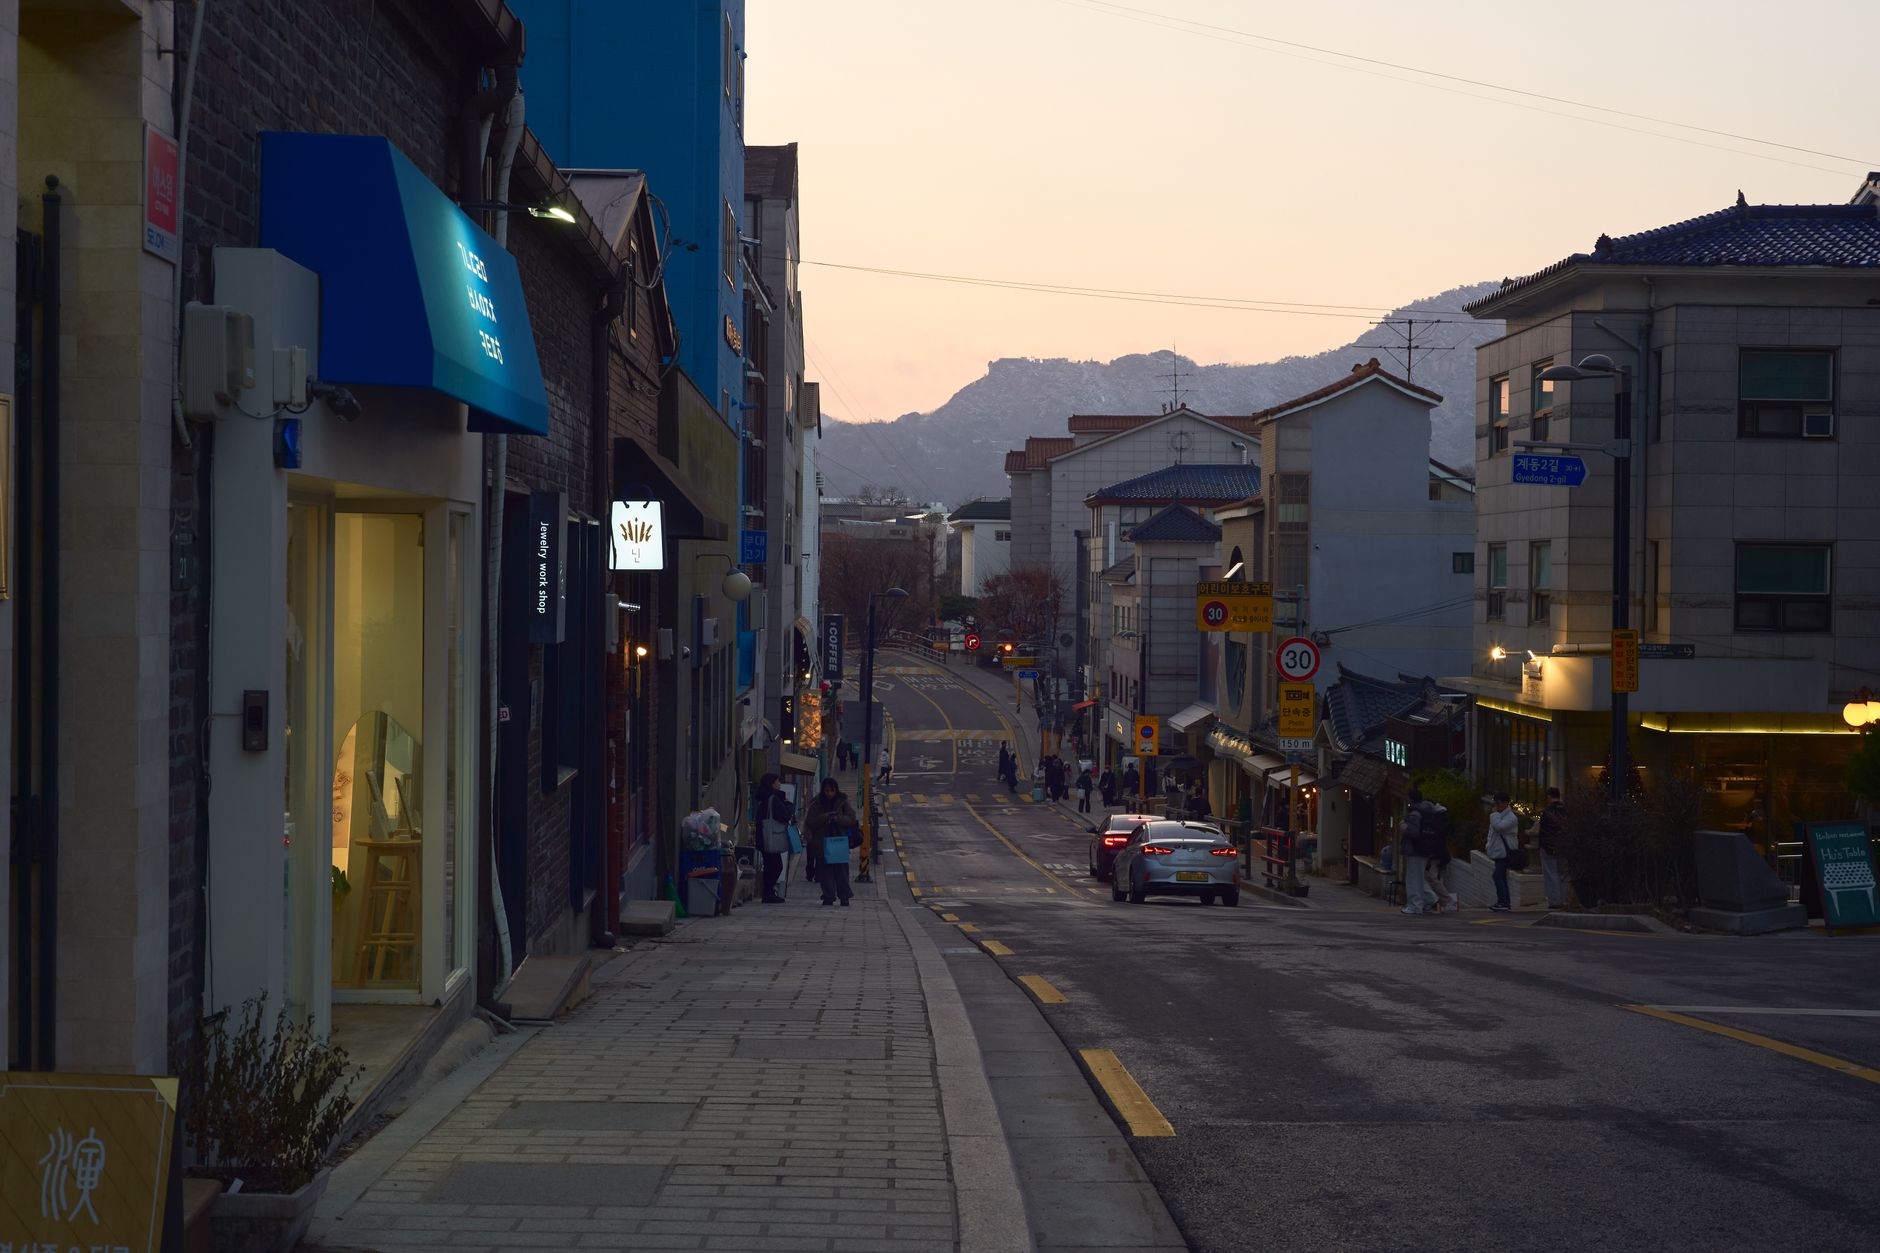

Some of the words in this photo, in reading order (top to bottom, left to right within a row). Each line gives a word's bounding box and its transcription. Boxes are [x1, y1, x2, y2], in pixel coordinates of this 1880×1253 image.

[1516, 457, 1560, 473] 계동2길
[1515, 472, 1548, 484] Gyedong
[1549, 474, 1567, 485] 2-gil
[538, 521, 550, 559] Jewelry
[539, 562, 549, 588] work
[537, 589, 549, 614] shop
[1208, 607, 1223, 621] 30
[829, 627, 838, 672] COFFEE
[1285, 650, 1311, 669] 30
[1282, 707, 1312, 718] 단속중
[1841, 846, 1868, 859] Table
